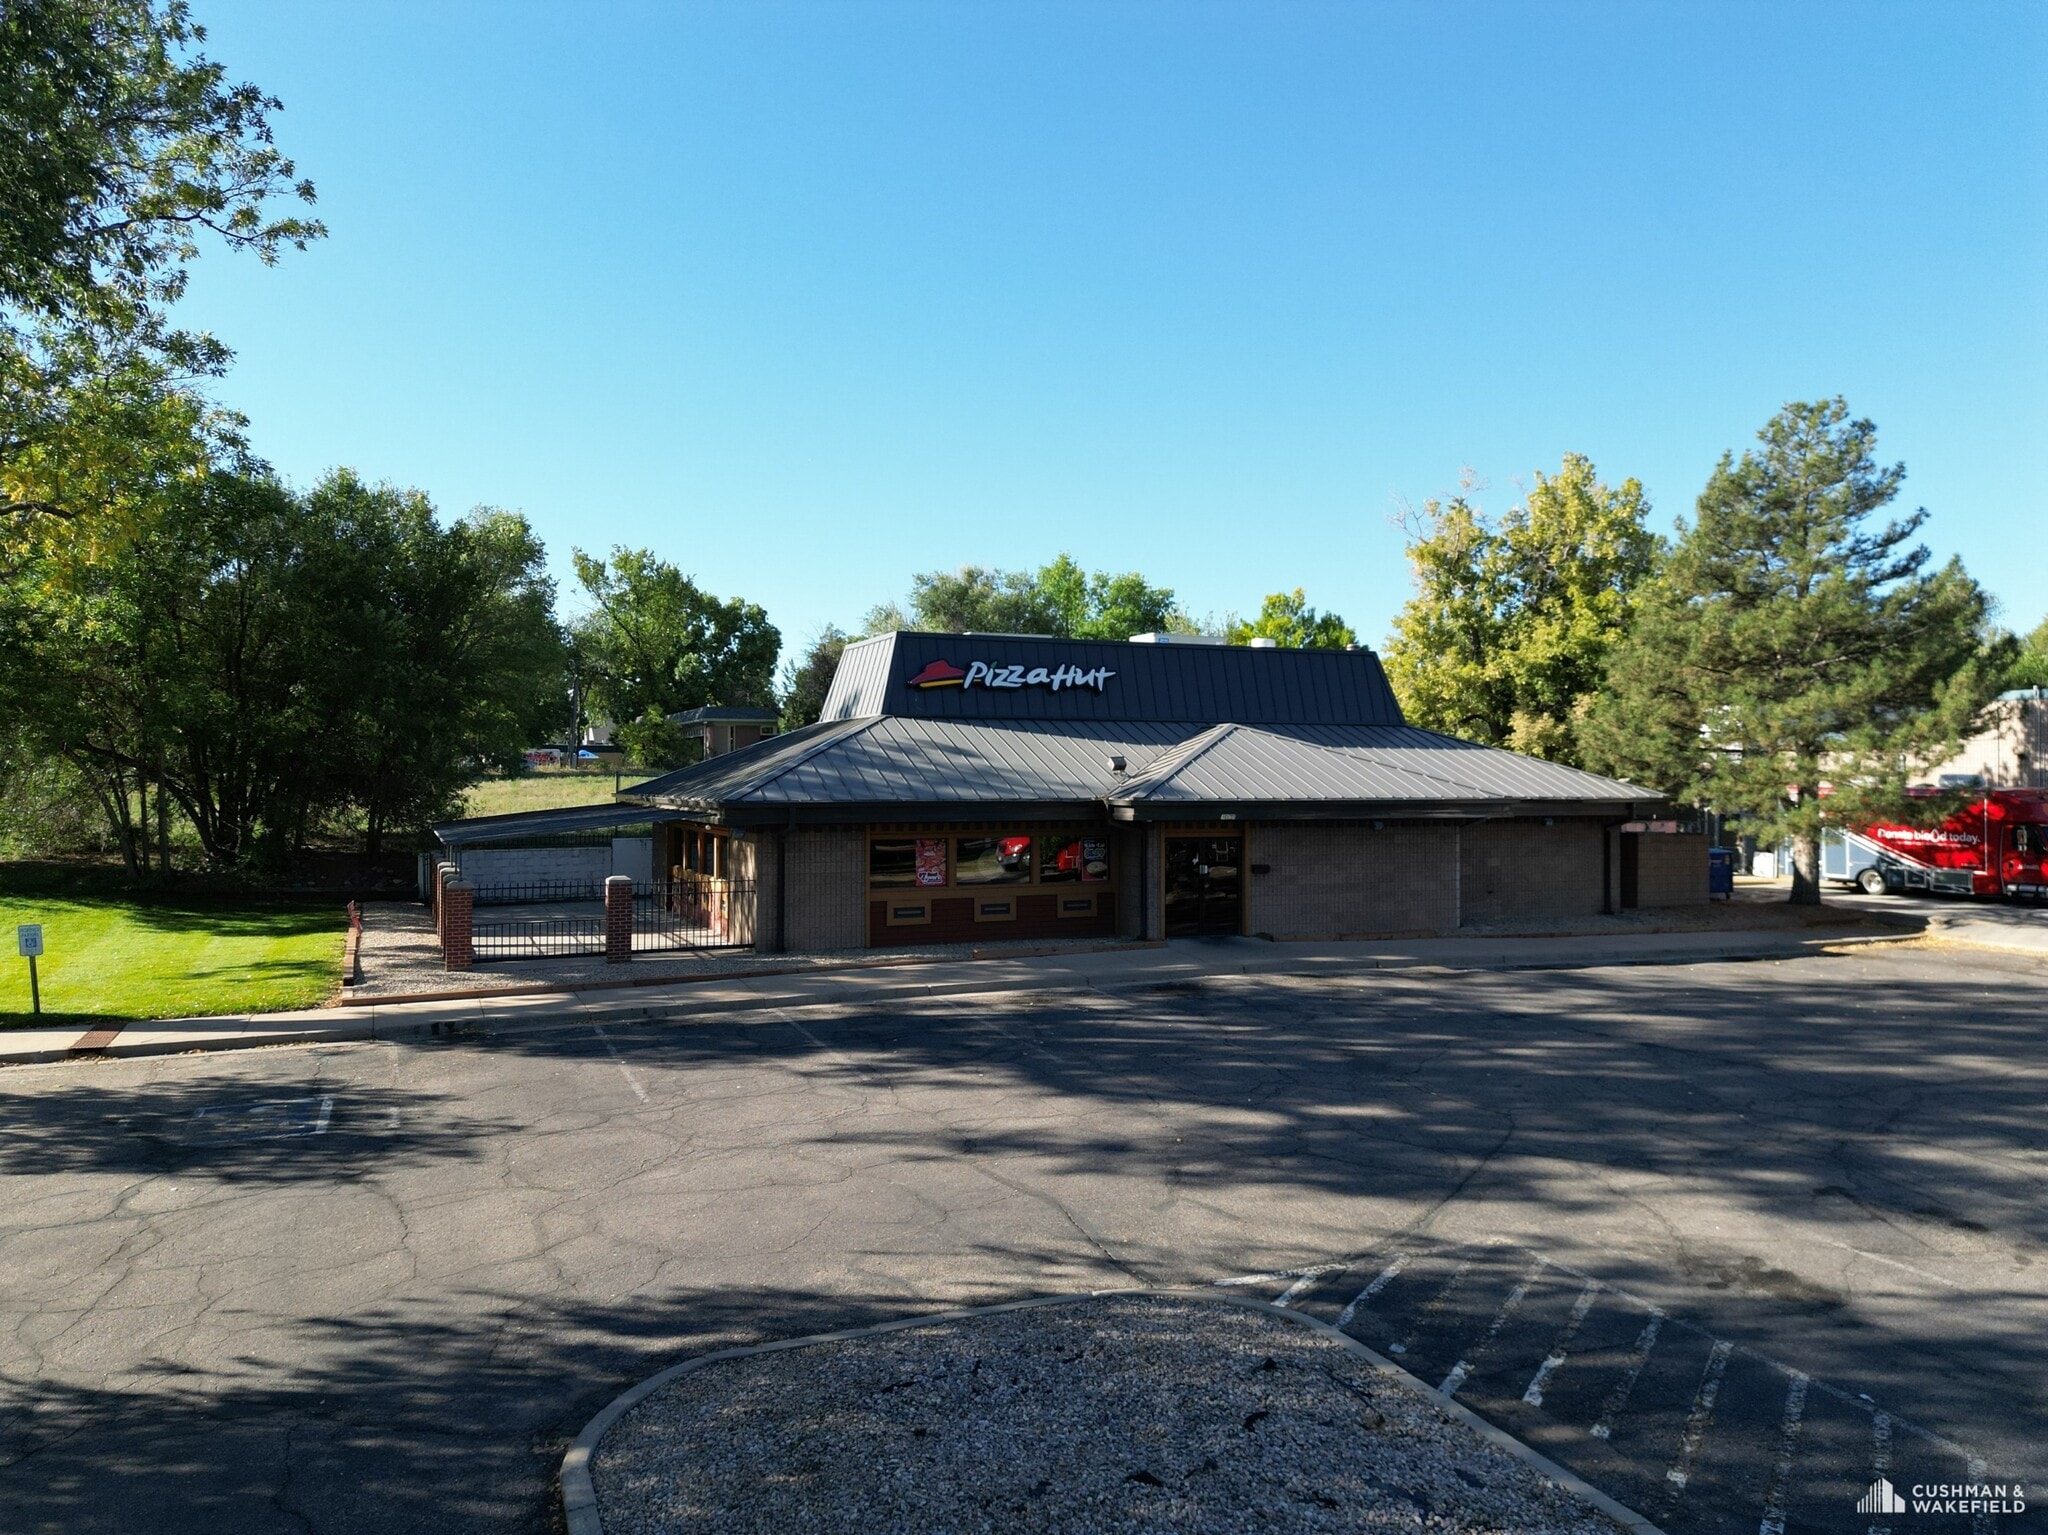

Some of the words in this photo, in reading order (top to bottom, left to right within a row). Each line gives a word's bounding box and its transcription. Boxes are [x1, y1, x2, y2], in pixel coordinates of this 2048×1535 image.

[963, 661, 1050, 689] Pizza
[1050, 663, 1116, 691] Hut
[1877, 828, 1913, 840] Donate
[1914, 828, 1947, 842] blood
